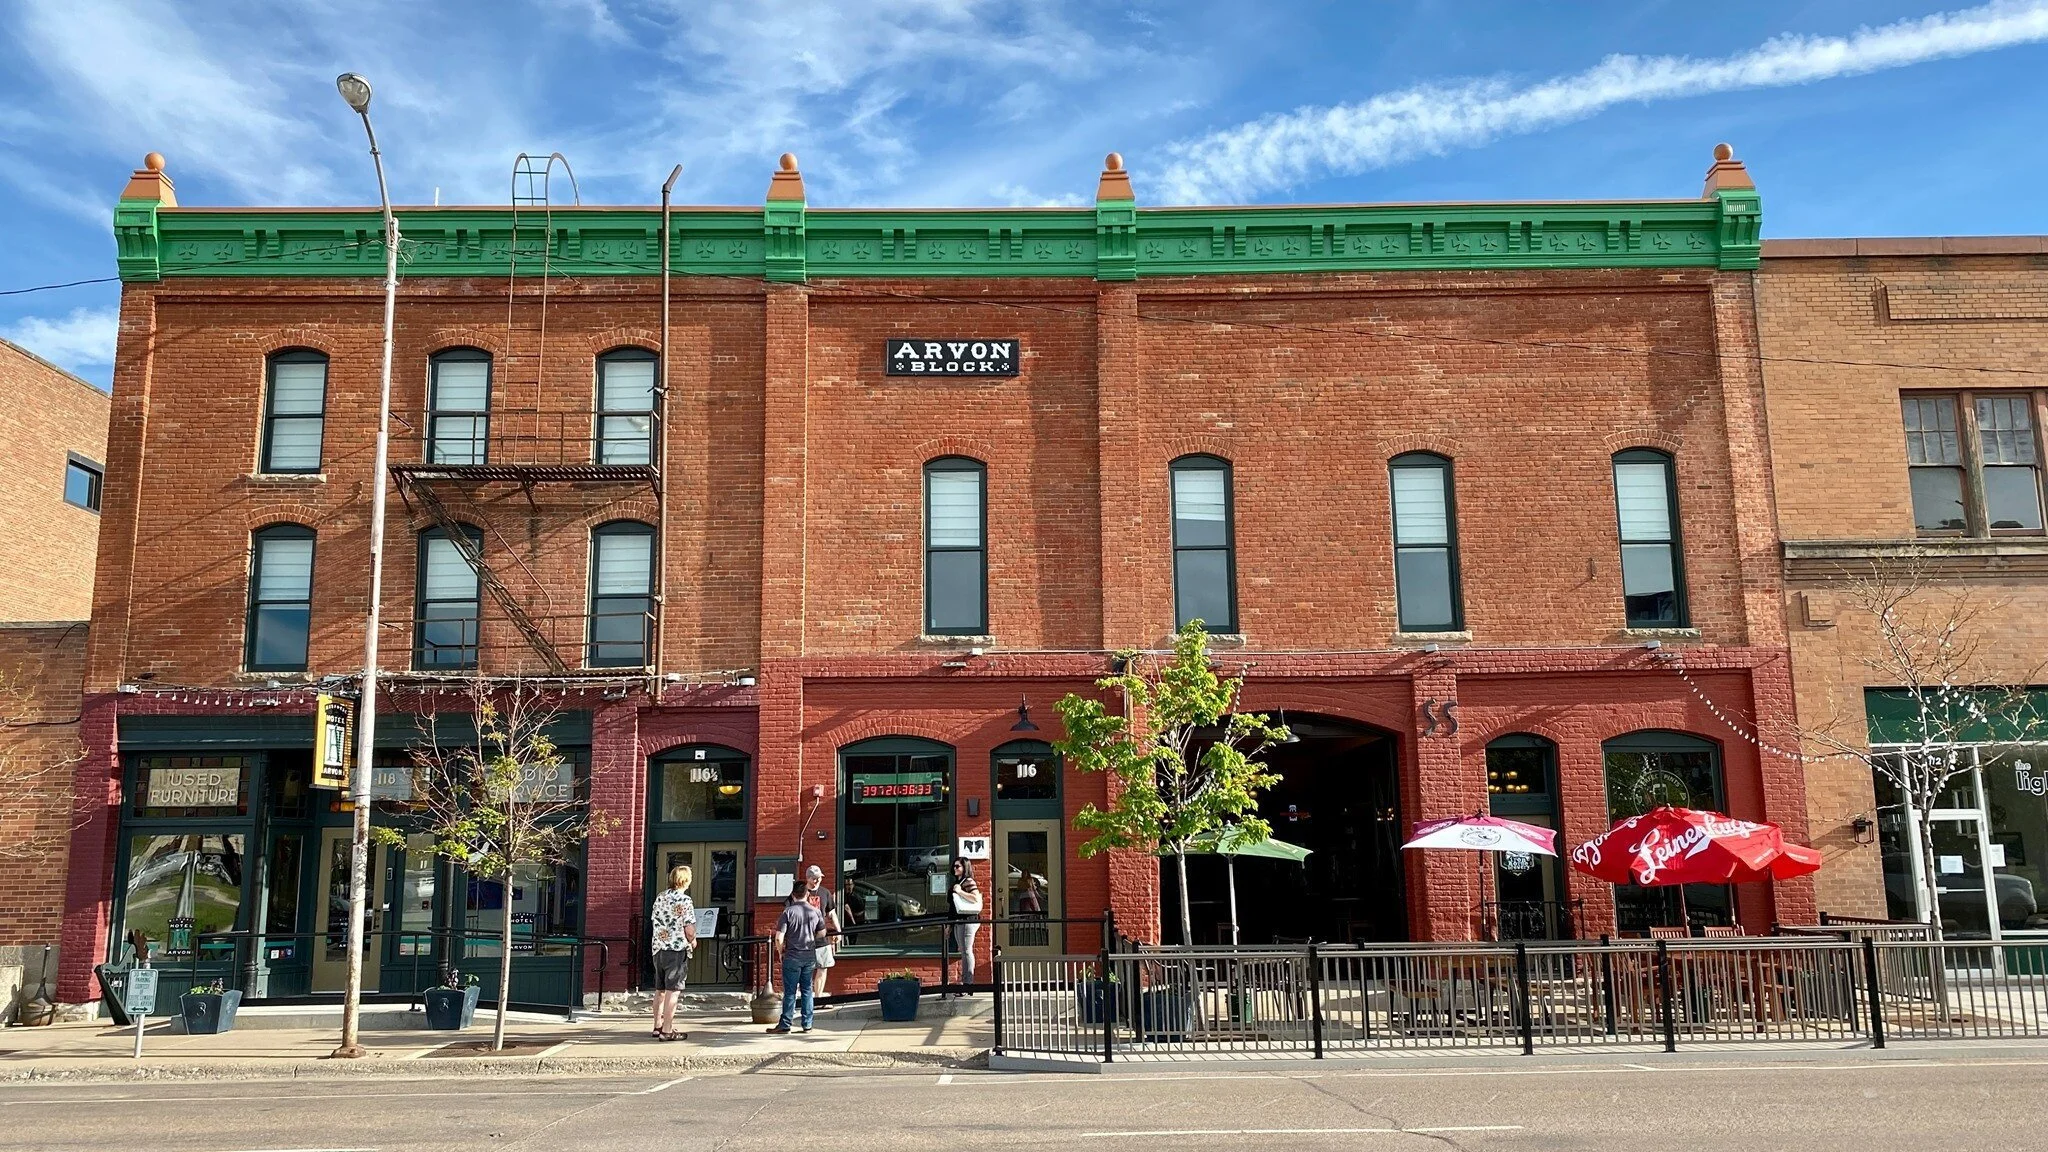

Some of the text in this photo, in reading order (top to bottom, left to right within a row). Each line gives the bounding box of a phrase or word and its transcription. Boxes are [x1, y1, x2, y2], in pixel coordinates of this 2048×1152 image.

[894, 342, 1011, 359] ARVON
[910, 361, 1000, 372] BLOCK.
[326, 715, 346, 724] HOTEL
[323, 767, 342, 776] ARVON
[1016, 764, 1037, 779] 116
[2015, 759, 2032, 771] the
[170, 773, 221, 786] USED
[2016, 770, 2048, 796] lig
[150, 789, 237, 803] FURNITURE
